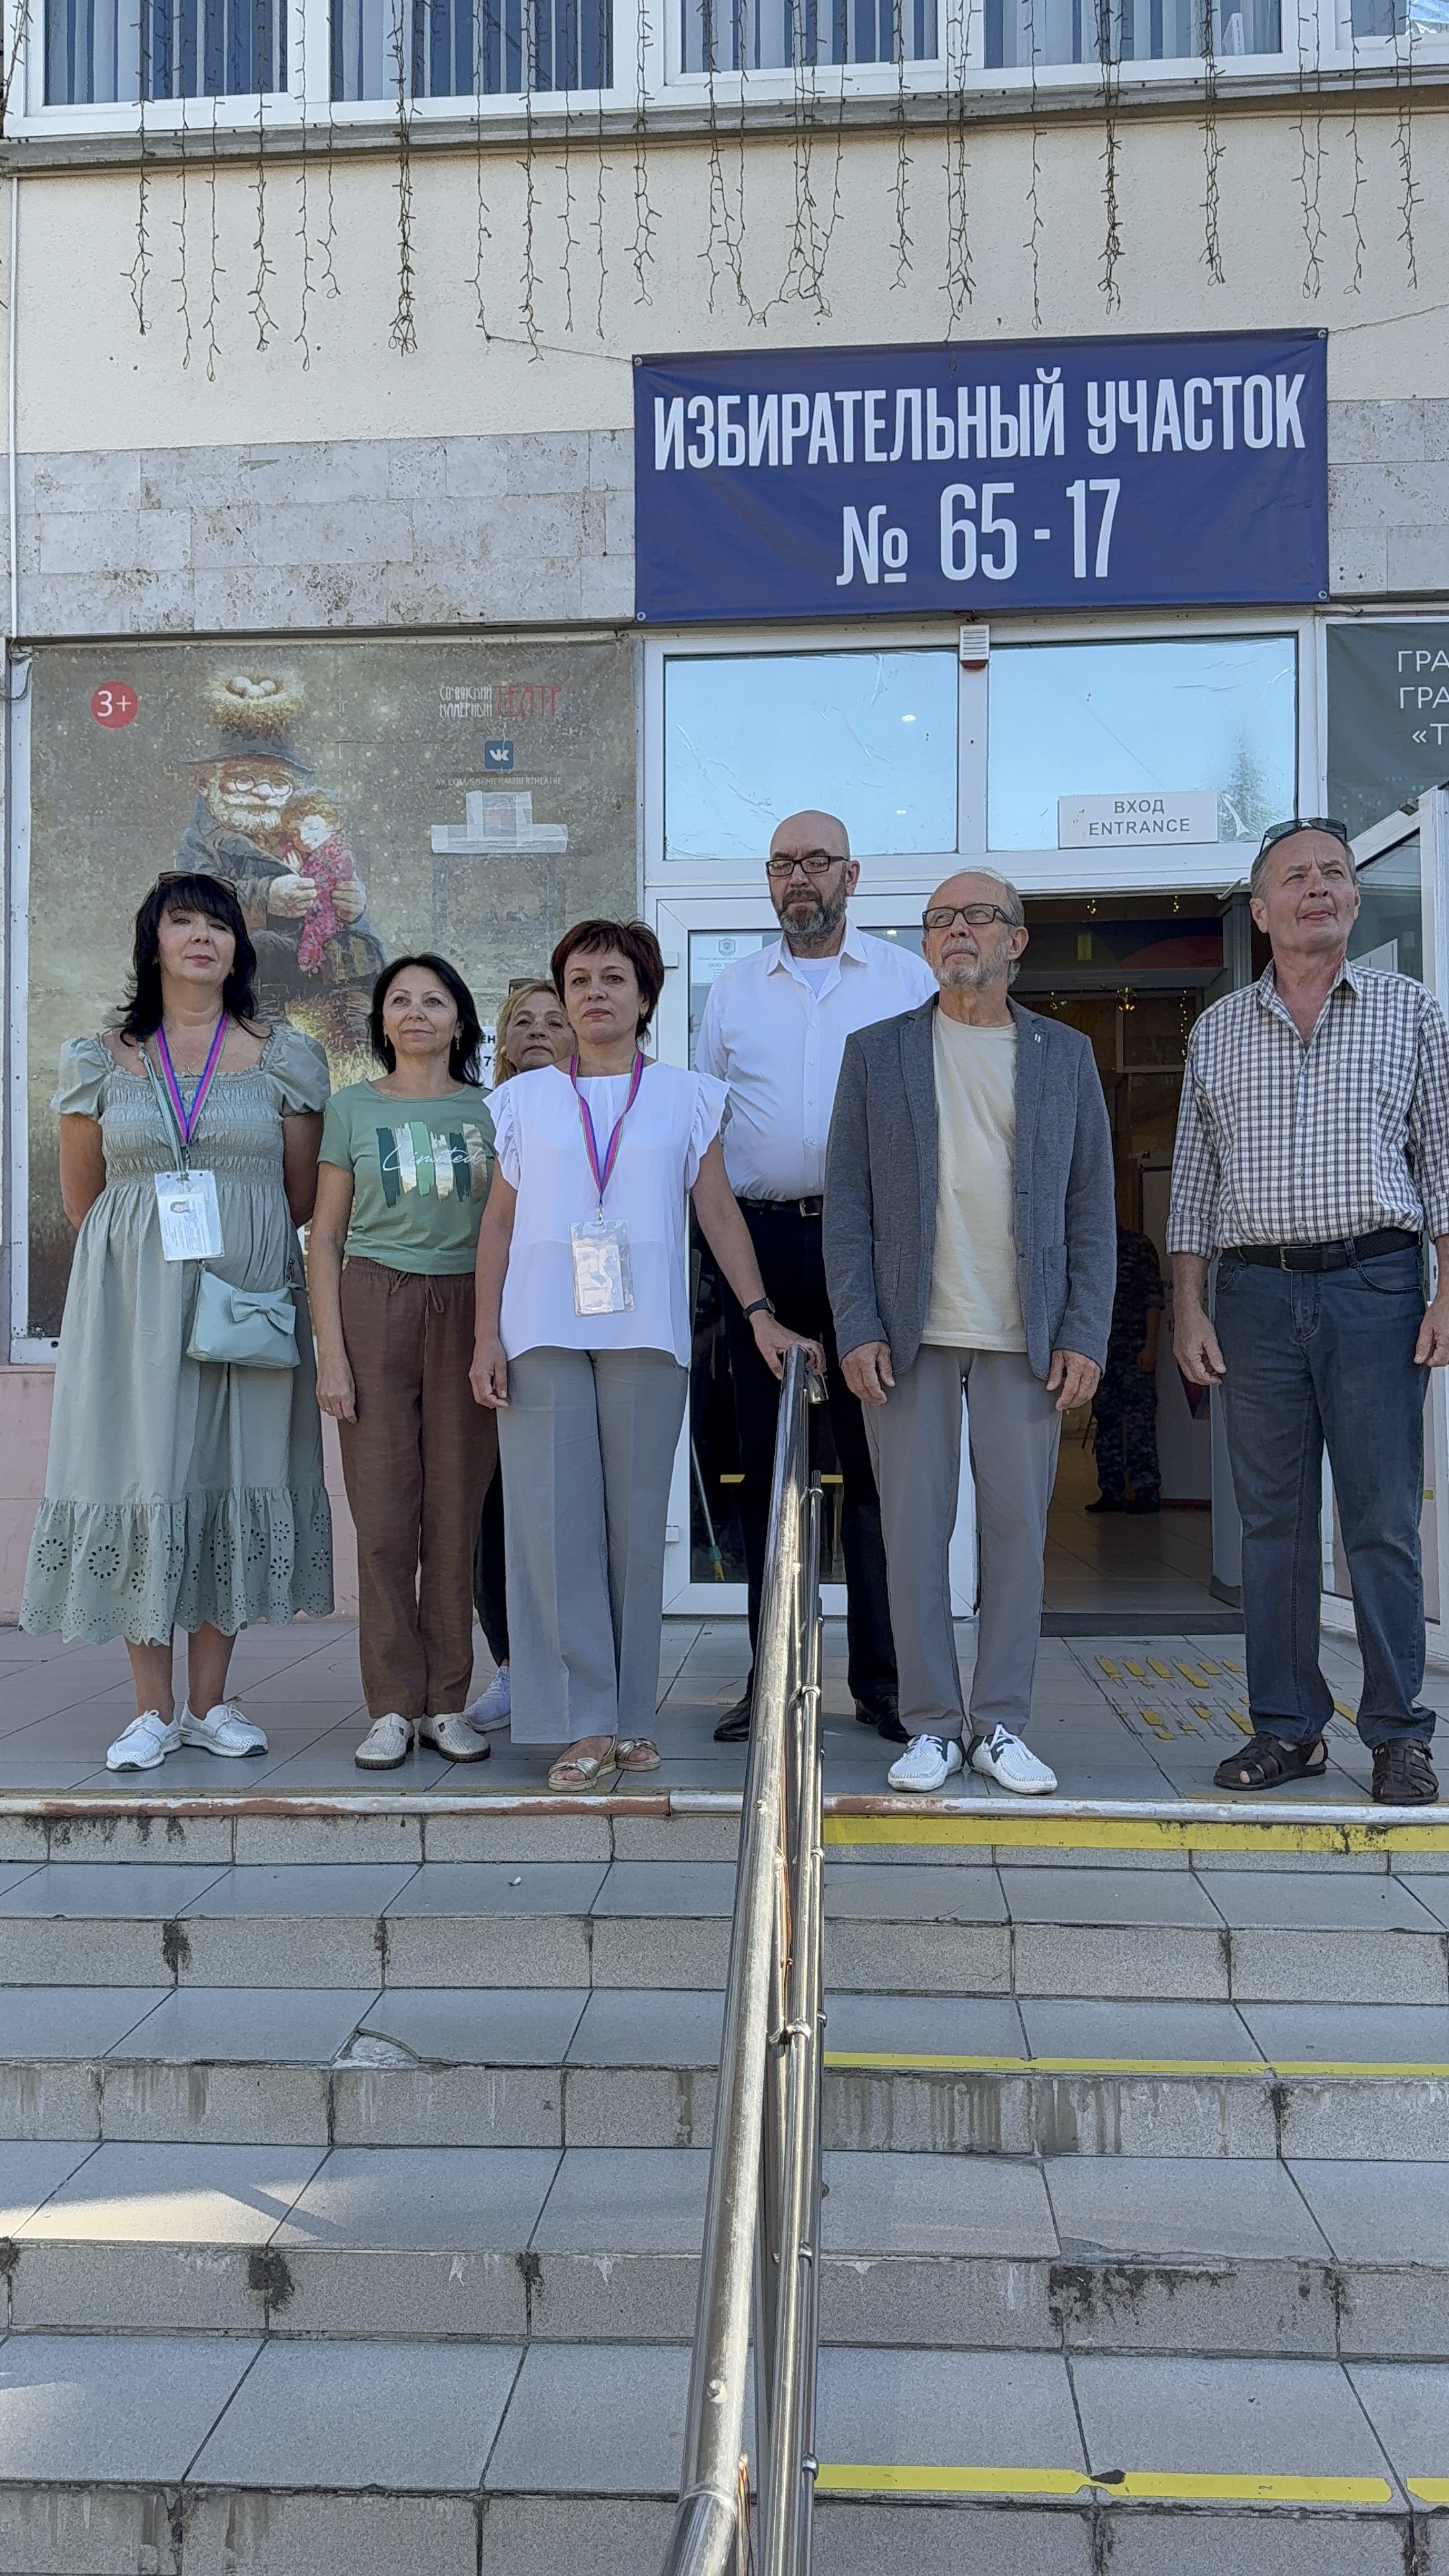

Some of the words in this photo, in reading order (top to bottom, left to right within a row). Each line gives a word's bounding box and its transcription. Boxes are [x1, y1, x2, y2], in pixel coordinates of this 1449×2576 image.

[654, 366, 1065, 470] ИЗБИРАТЕЛЬНЫЙ
[1087, 374, 1305, 455] УЧАСТОК
[836, 504, 908, 586] №
[97, 690, 132, 717] 3+
[439, 684, 493, 701] СОЧИНСКИЙ
[493, 684, 562, 717] ТЕАТР
[439, 702, 493, 718] КАМЕРНЫЙ
[1114, 800, 1165, 815] ВХОД
[1089, 818, 1190, 836] ENTRANCE
